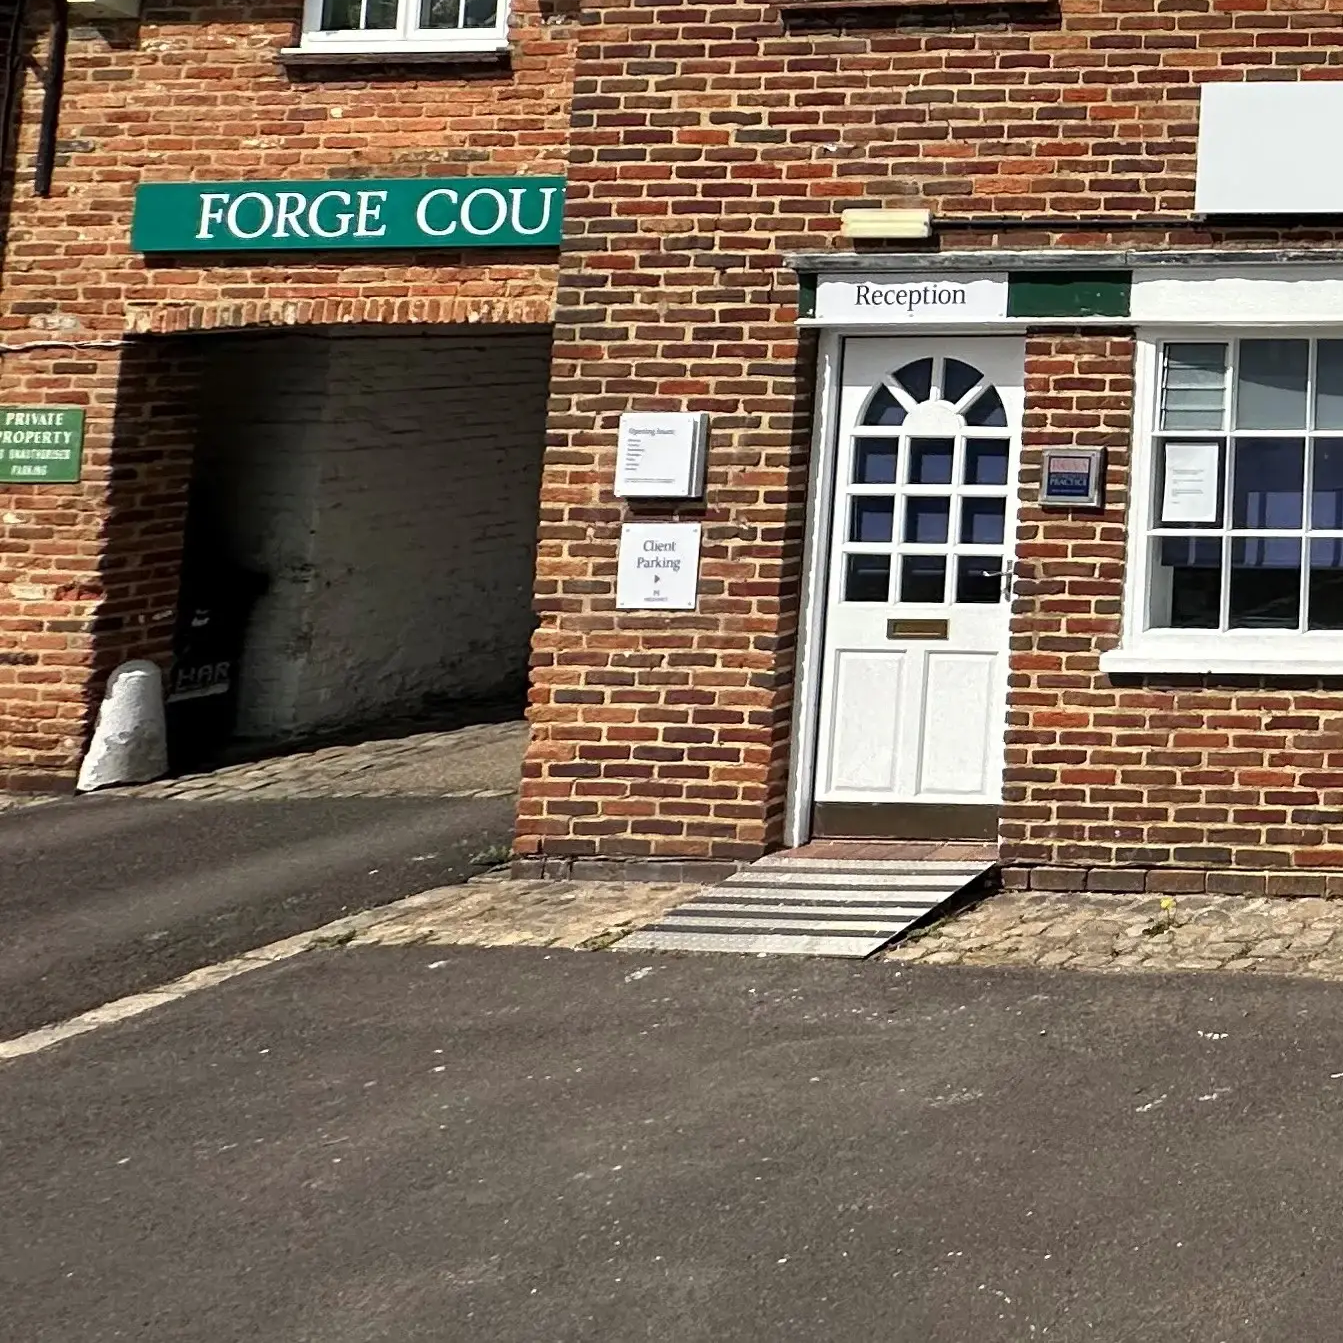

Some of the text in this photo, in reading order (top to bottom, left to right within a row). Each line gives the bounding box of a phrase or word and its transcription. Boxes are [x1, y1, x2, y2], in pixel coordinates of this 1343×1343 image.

[195, 187, 566, 239] FORGE COU
[854, 284, 967, 312] Reception
[6, 412, 65, 426] PRIVATE
[643, 540, 676, 552] Client
[636, 556, 681, 572] Parking
